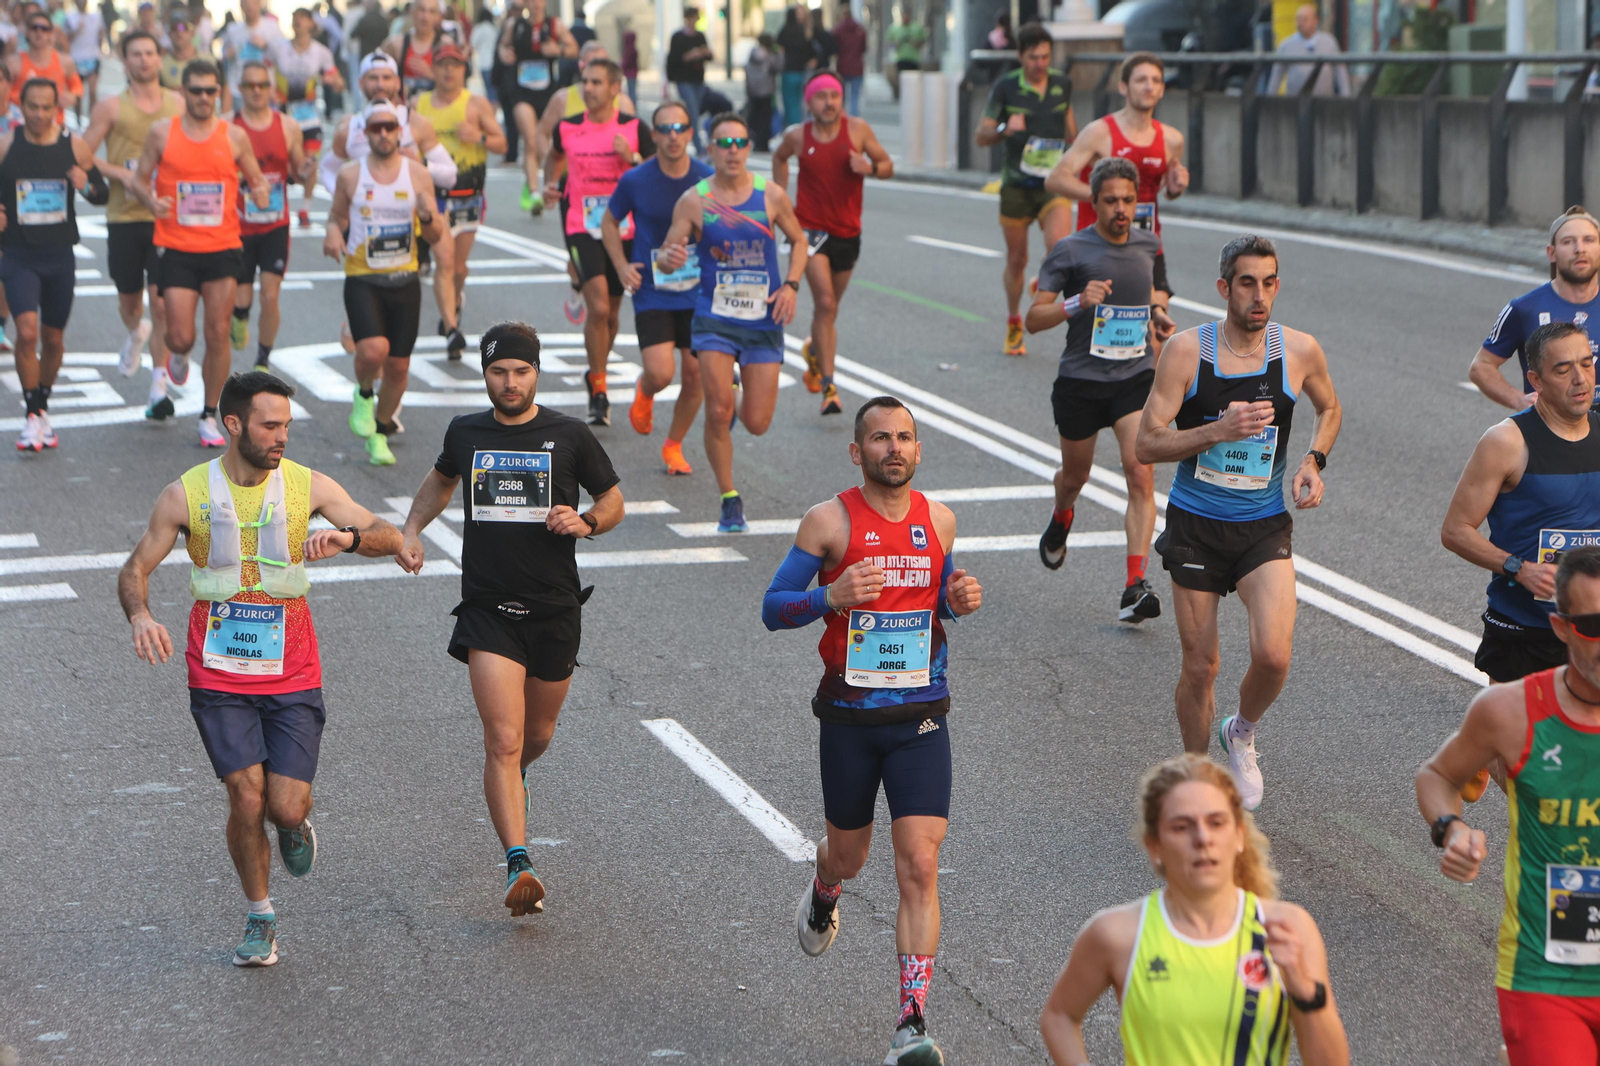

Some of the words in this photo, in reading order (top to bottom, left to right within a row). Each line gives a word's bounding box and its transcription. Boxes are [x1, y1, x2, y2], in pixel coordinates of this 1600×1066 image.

[724, 297, 754, 309] TOMI
[1116, 310, 1146, 319] ZURICH
[1115, 328, 1133, 336] 4531
[1224, 450, 1248, 461] 4408
[499, 457, 540, 468] ZURICH
[1224, 464, 1245, 474] DANI
[498, 480, 523, 491] 2568
[494, 496, 527, 505] ADRIEN
[886, 555, 932, 569] ATLETISMO
[234, 608, 275, 620] ZURICH
[880, 616, 922, 629] ZURICH
[232, 631, 258, 644] 4400
[226, 646, 263, 658] NICOLAS
[879, 643, 904, 655] 6451
[876, 660, 907, 670] JORGE
[918, 723, 940, 735] adidas
